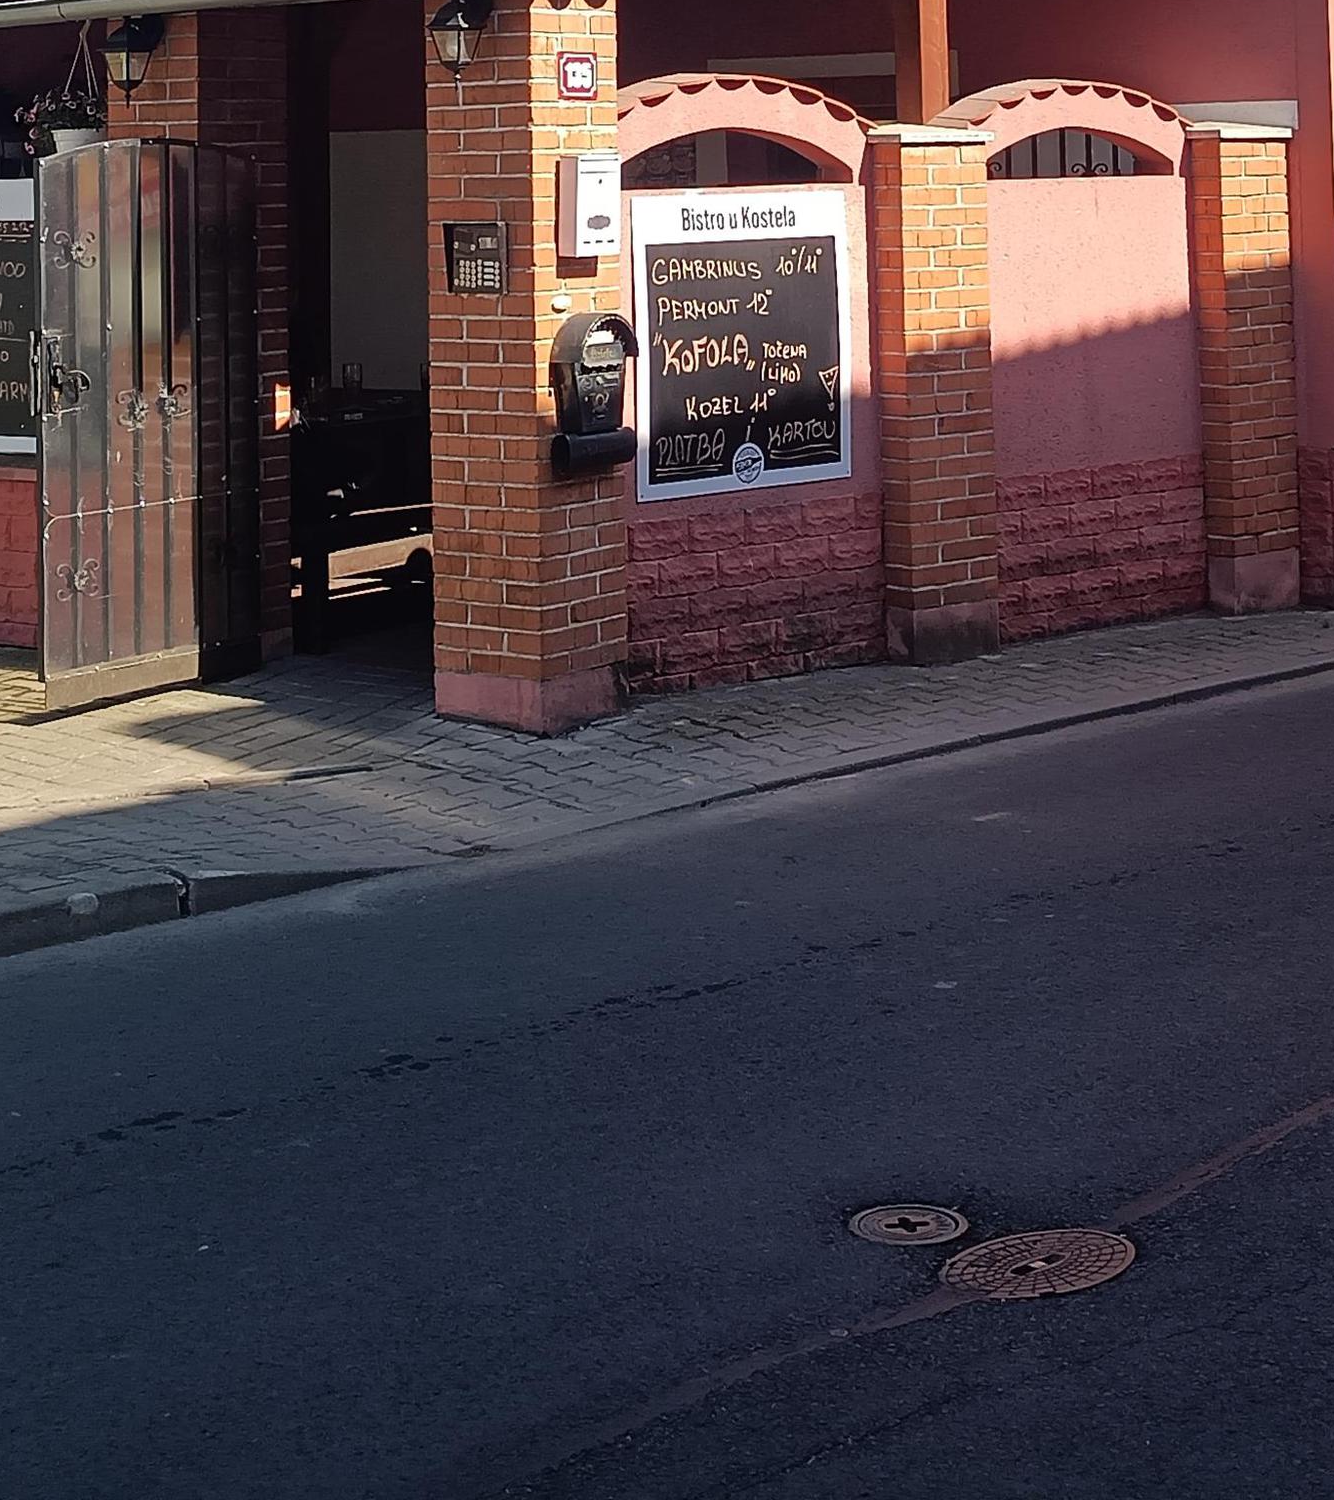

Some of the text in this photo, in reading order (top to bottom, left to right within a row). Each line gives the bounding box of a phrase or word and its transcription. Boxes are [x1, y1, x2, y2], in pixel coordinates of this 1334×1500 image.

[681, 205, 796, 231] Bistro u Kostela
[651, 258, 762, 286] GAMBRINUS
[656, 296, 740, 327] PERMONT
[686, 396, 743, 421] KOZEL
[655, 428, 726, 466] PLATBA
[768, 419, 836, 450] KARTOU
